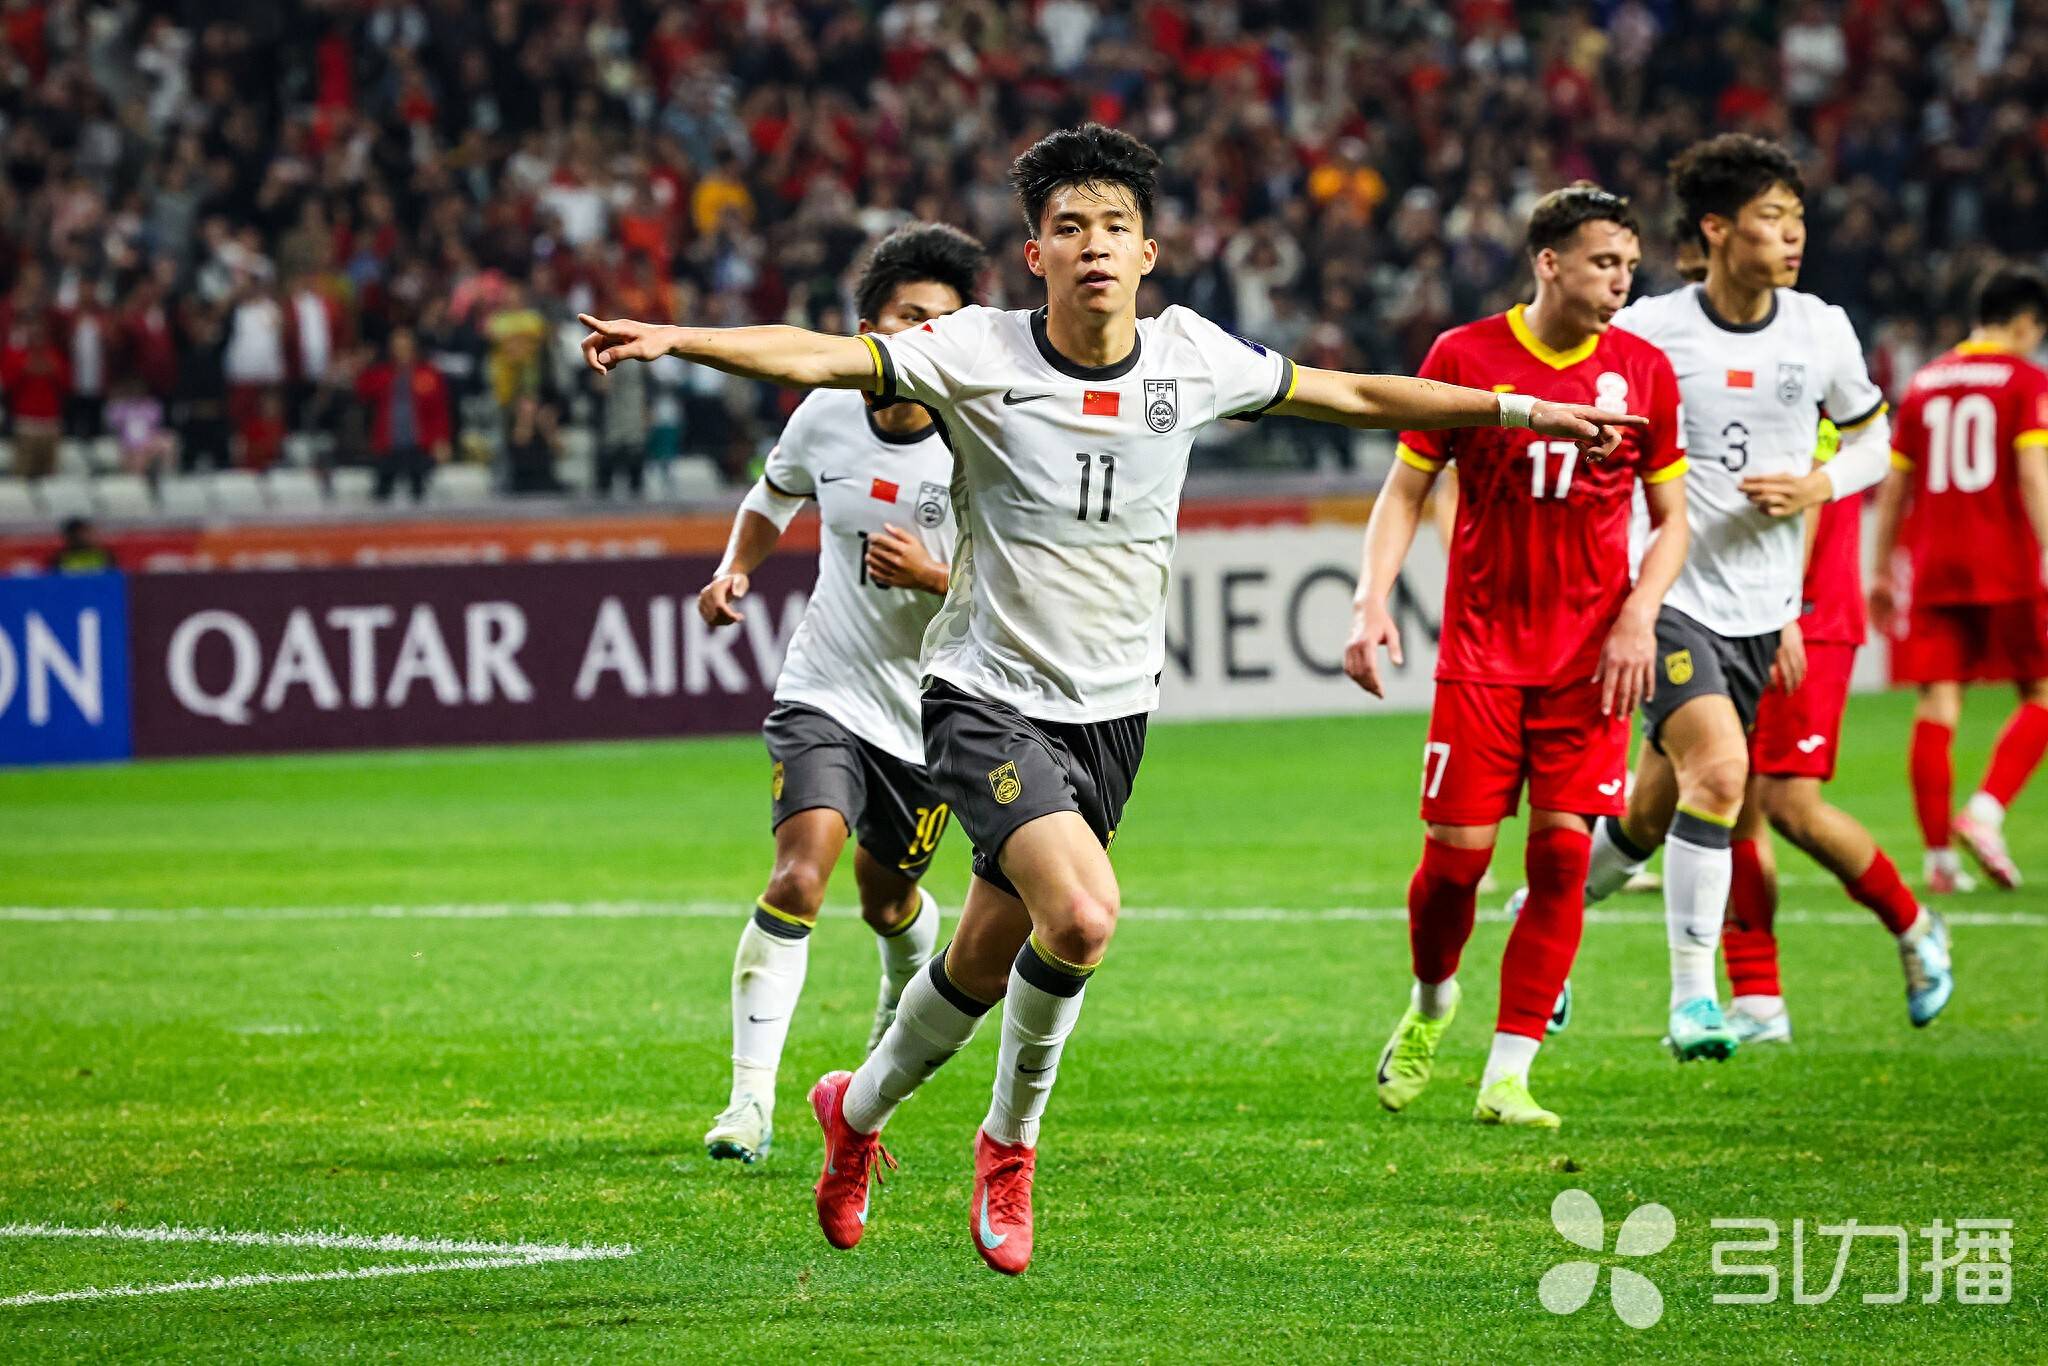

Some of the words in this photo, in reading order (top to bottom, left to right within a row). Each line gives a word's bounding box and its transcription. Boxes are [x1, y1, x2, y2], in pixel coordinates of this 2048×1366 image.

[1147, 382, 1174, 392] CFA
[1527, 441, 1580, 499] 17
[1721, 422, 1750, 472] 3
[1922, 393, 1998, 494] 10
[1076, 453, 1115, 522] 11
[0, 607, 104, 727] N
[167, 602, 534, 725] QATAR
[909, 802, 949, 856] 10
